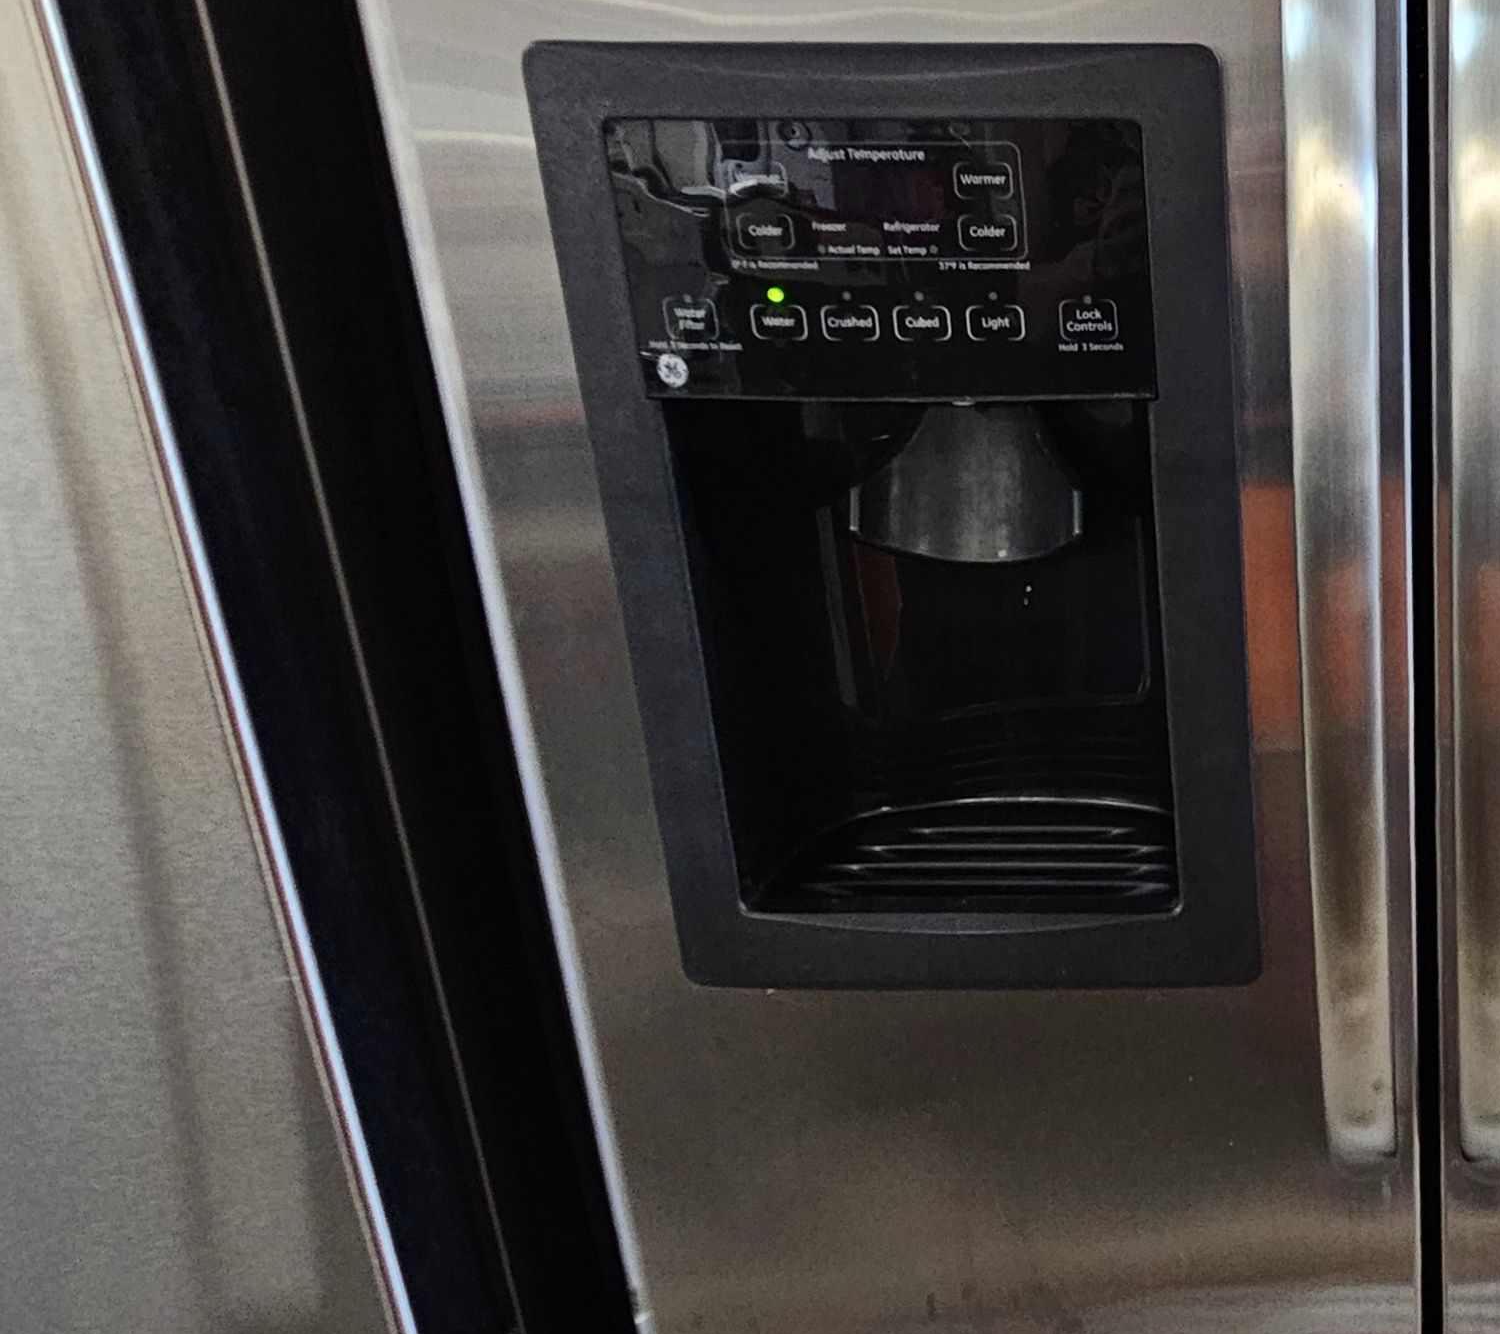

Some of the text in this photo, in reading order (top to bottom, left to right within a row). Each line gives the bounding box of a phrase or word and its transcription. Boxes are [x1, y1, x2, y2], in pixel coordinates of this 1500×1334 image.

[808, 147, 925, 164] Adjust Temperature
[960, 174, 1006, 185] Warmer
[748, 224, 783, 237] Colder
[812, 221, 847, 232] Freezer
[883, 220, 940, 234] Refrigerator
[969, 225, 1006, 238] Colder
[828, 245, 880, 256] Actual Temp
[887, 245, 928, 256] Set Temp
[757, 260, 819, 270] Recommended
[967, 261, 1031, 271] Recommended
[673, 307, 707, 318] Water
[1076, 308, 1102, 320] Lock
[762, 317, 796, 327] Water
[827, 317, 873, 329] Crushed
[905, 316, 940, 329] Cubed
[981, 317, 1010, 331] Light
[1066, 320, 1113, 332] Controls
[1058, 343, 1078, 352] Hold
[1089, 343, 1124, 351] Seconds
